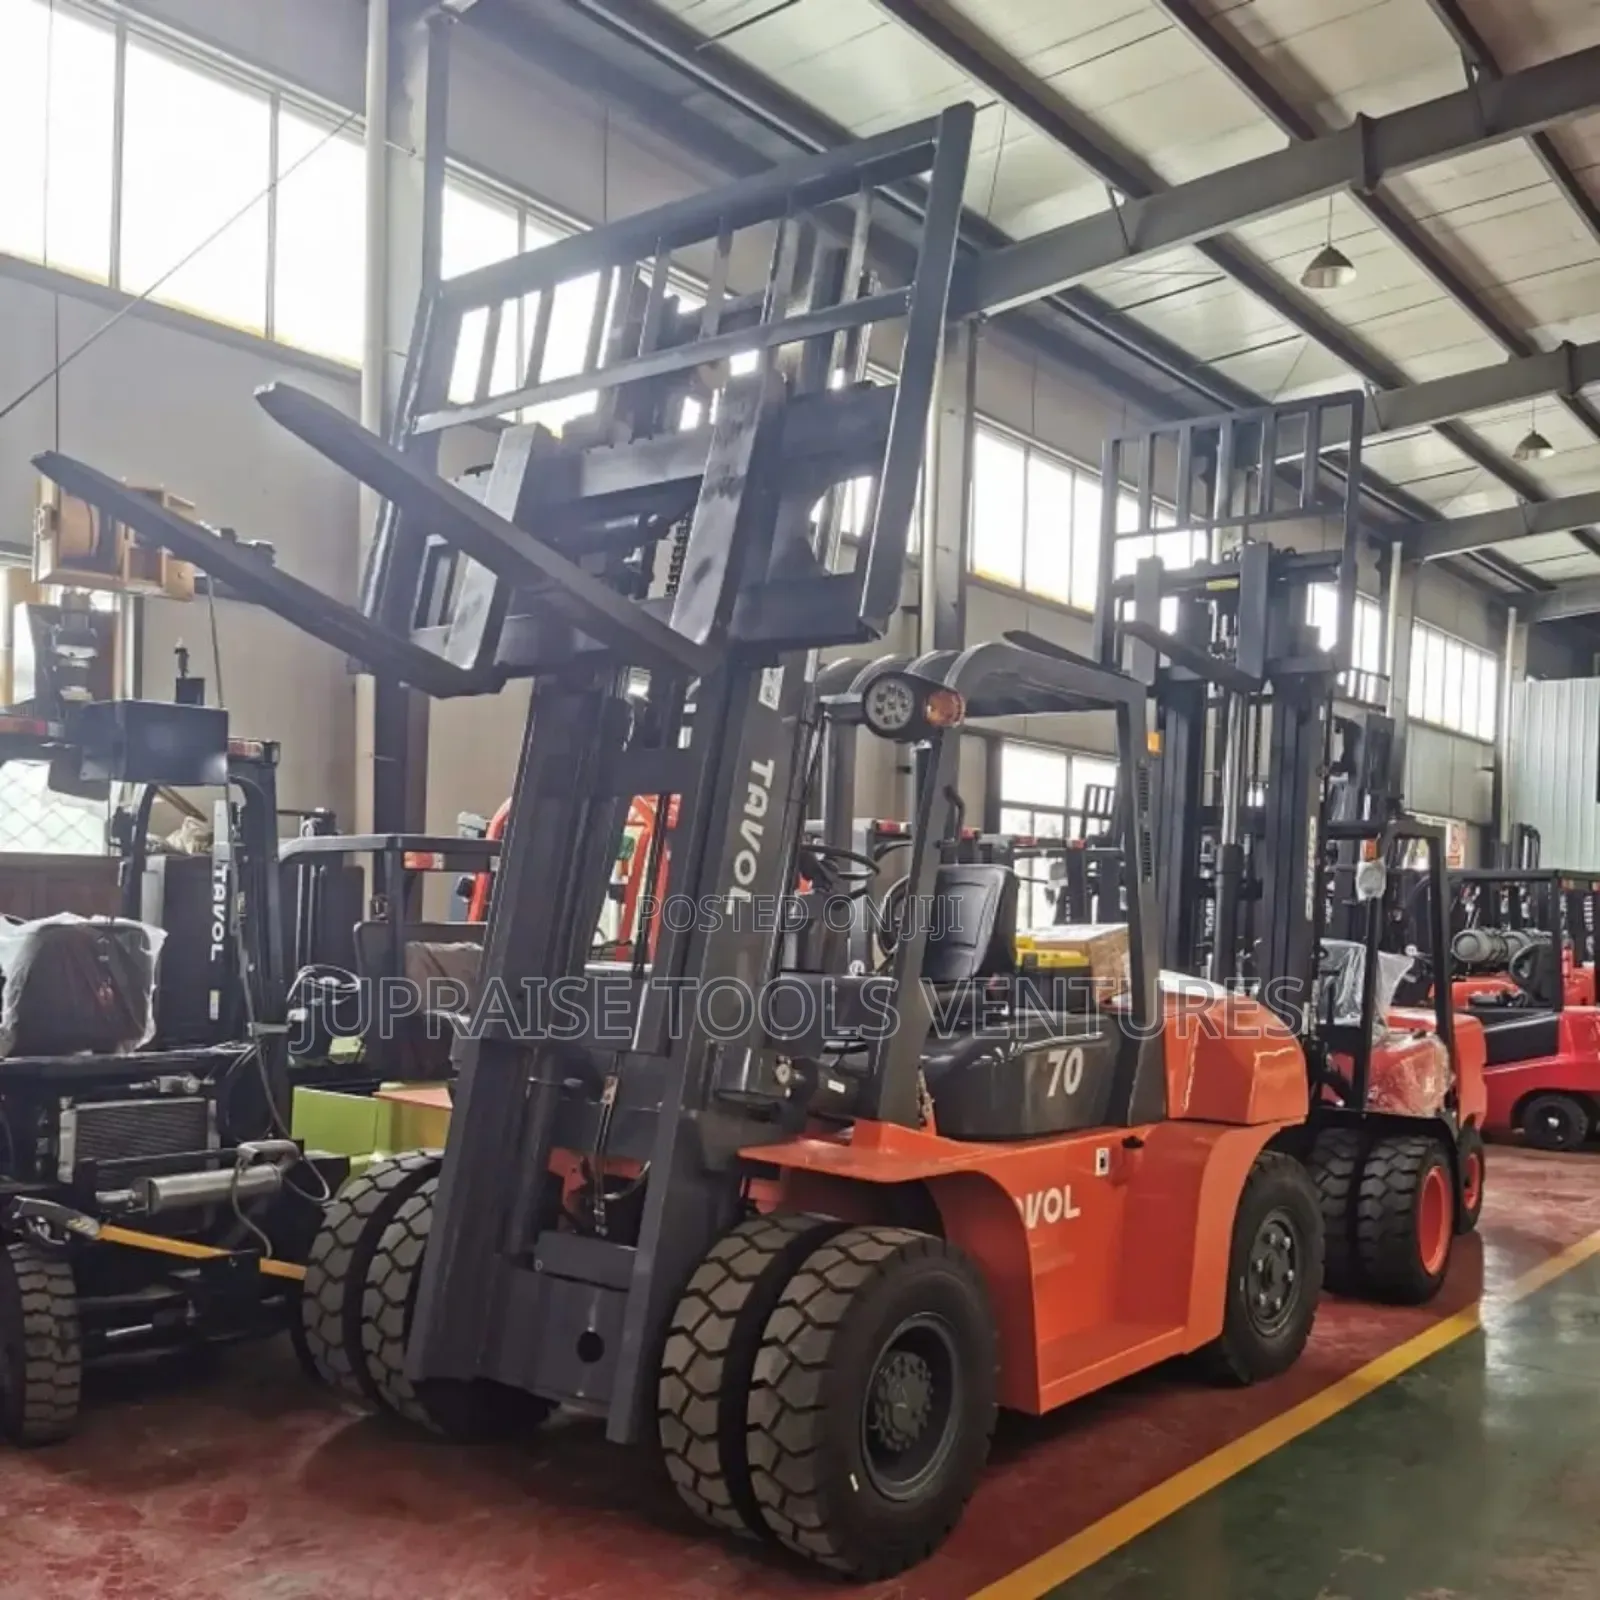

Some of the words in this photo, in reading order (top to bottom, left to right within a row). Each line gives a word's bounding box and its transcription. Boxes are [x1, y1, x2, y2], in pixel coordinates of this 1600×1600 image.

[725, 759, 775, 915] TAVOL
[211, 863, 228, 962] TAVOL
[1046, 1047, 1084, 1098] 70
